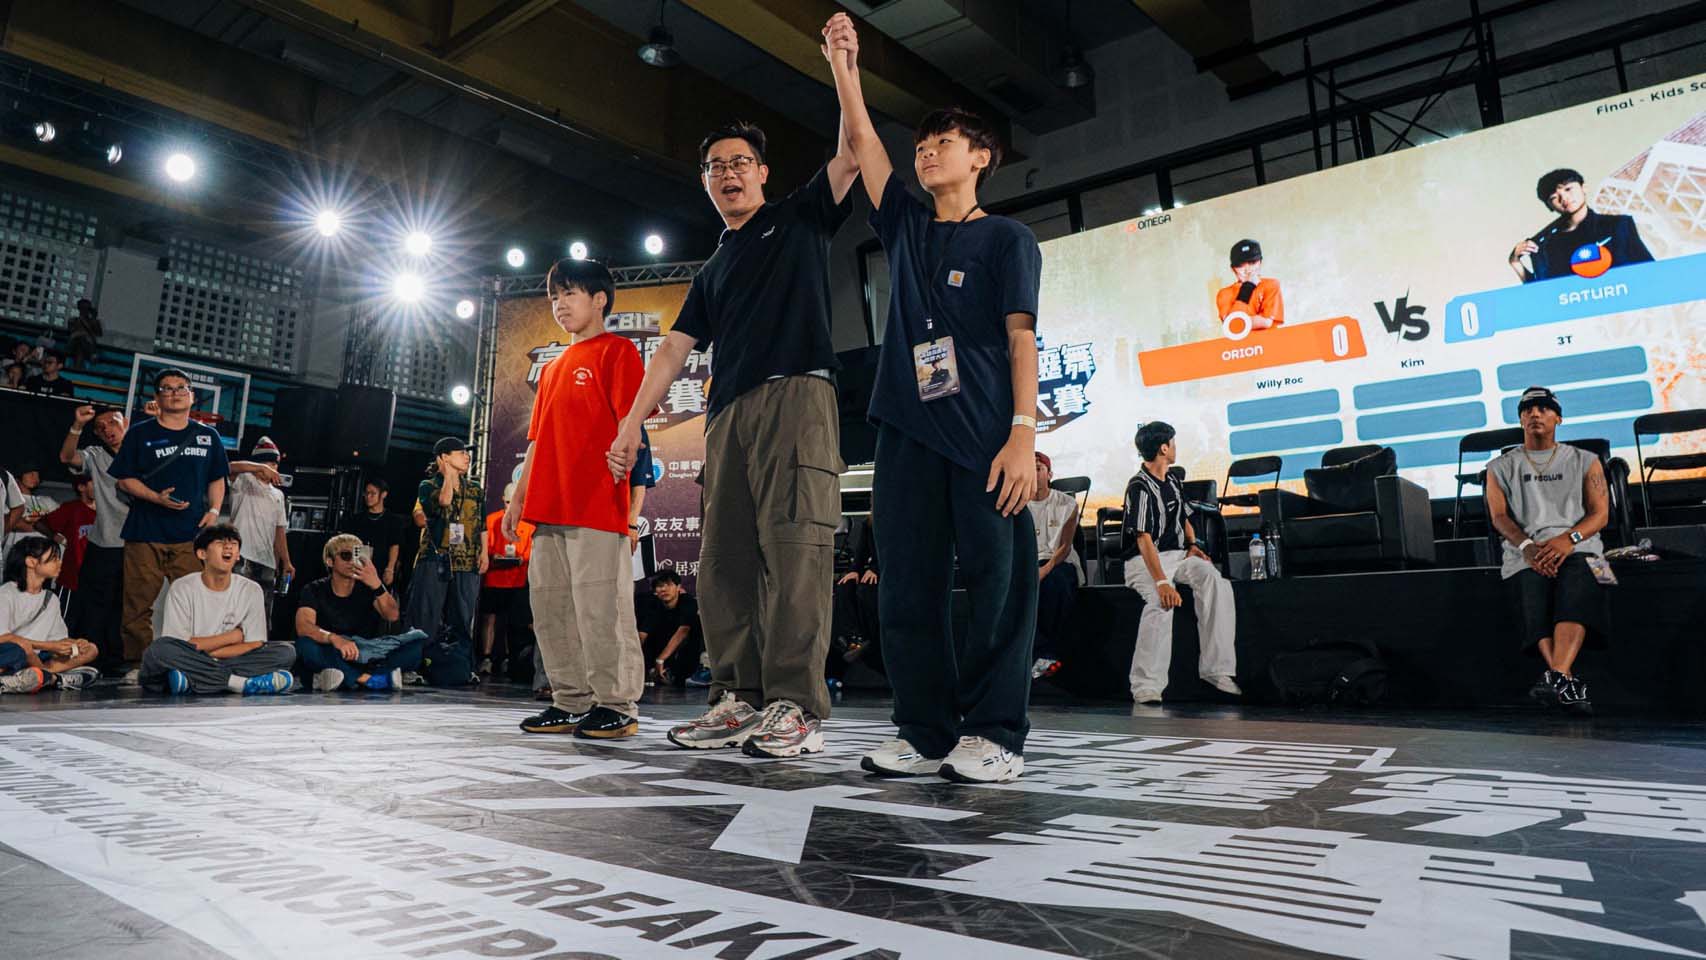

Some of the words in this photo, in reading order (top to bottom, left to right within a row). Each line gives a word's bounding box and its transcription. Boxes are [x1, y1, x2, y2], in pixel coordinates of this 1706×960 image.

[1596, 98, 1634, 115] Final
[1650, 87, 1684, 102] Kids
[1137, 214, 1172, 231] OMEGA
[1558, 284, 1628, 306] SATURN
[1373, 288, 1431, 342] VS
[1460, 302, 1480, 337] 0
[1332, 323, 1349, 357] 0
[1557, 335, 1573, 346] 3T
[1221, 345, 1264, 362] ORION
[1401, 358, 1425, 369] Kim
[1256, 379, 1283, 391] Willy
[1285, 376, 1304, 387] Roc
[183, 447, 207, 457] CREW
[668, 460, 706, 472] 中華電
[653, 517, 701, 532] 友友事
